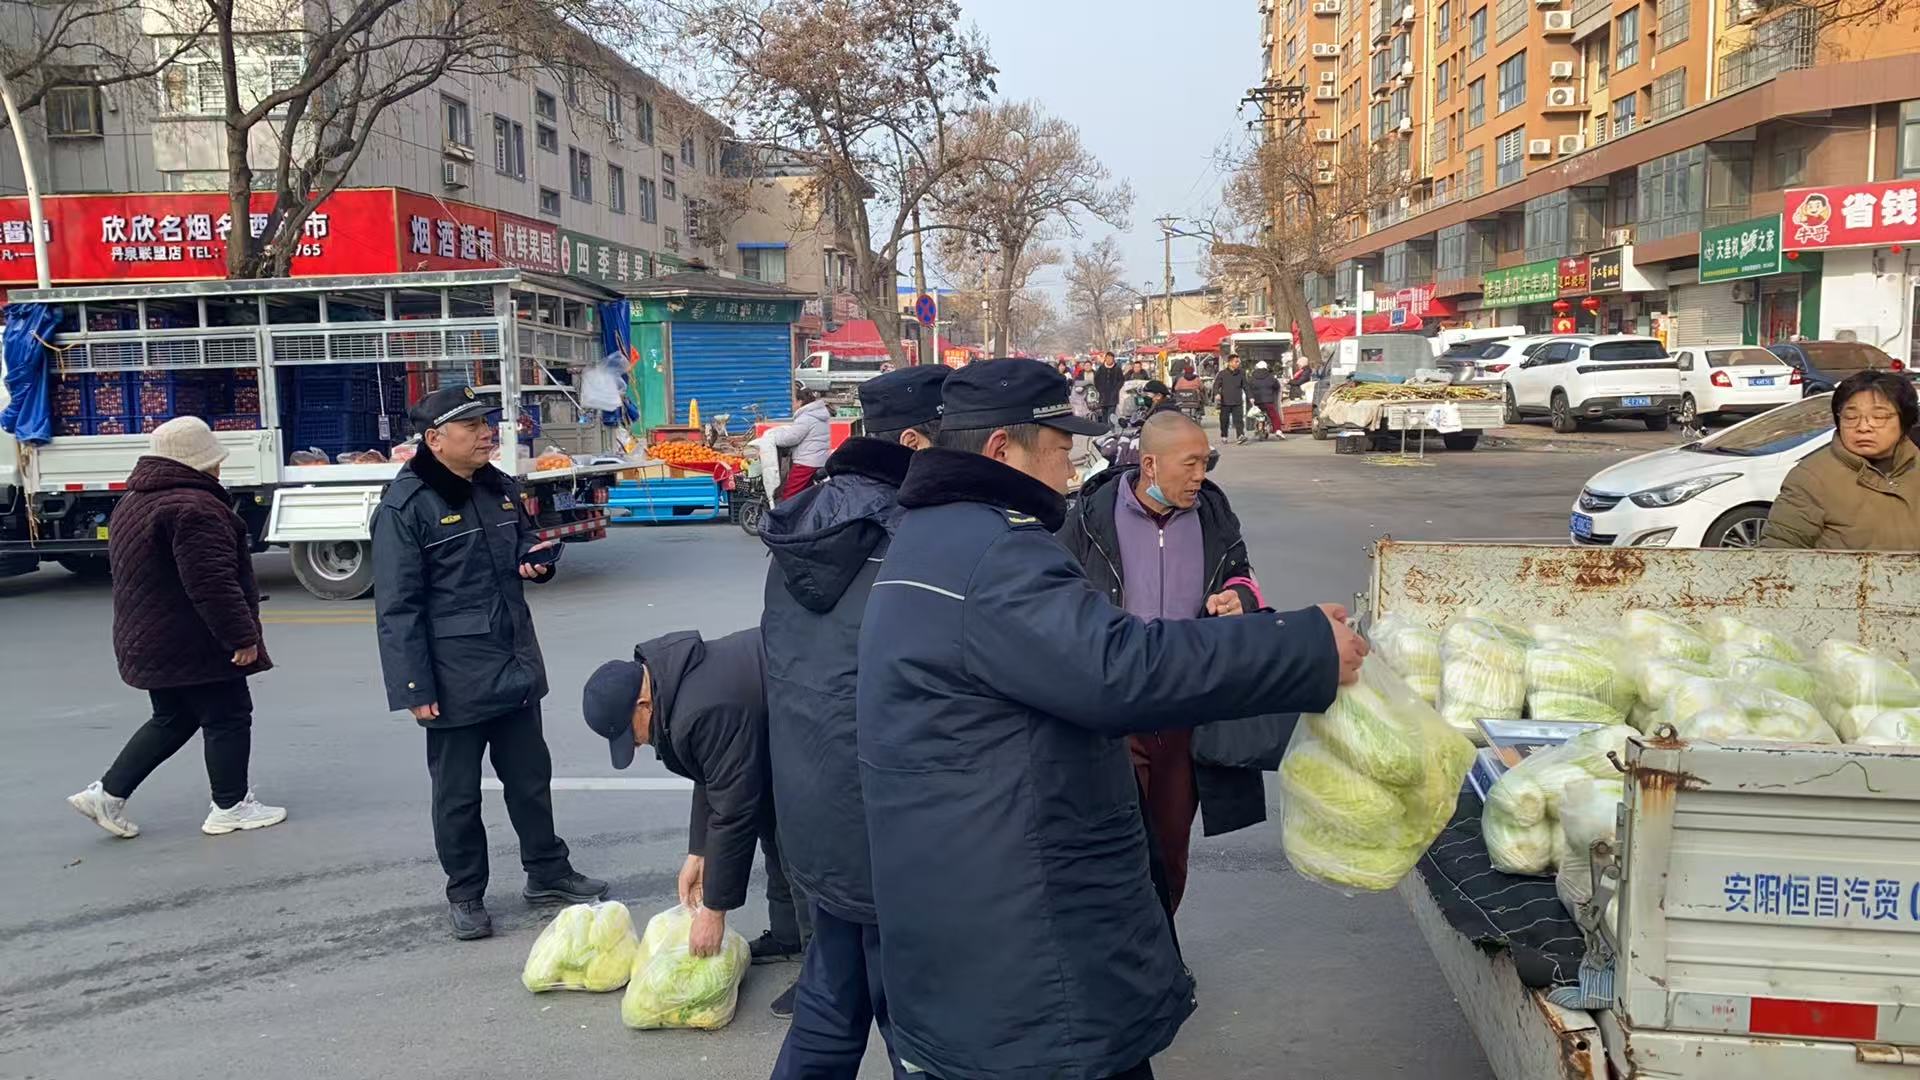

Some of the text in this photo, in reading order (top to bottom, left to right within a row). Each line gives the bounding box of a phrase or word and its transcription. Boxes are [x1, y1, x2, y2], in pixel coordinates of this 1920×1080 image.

[101, 211, 328, 242] 欣欣名烟名酒市
[1841, 188, 1918, 230] 省钱
[111, 246, 182, 261] 丹泉联盟店
[411, 215, 494, 262] 烟酒超市
[503, 223, 552, 264] 优鲜果园
[1794, 224, 1831, 244] 牛哥
[577, 242, 645, 281] 四季鲜果
[1724, 872, 1900, 921] 安阳恒昌汽贸
